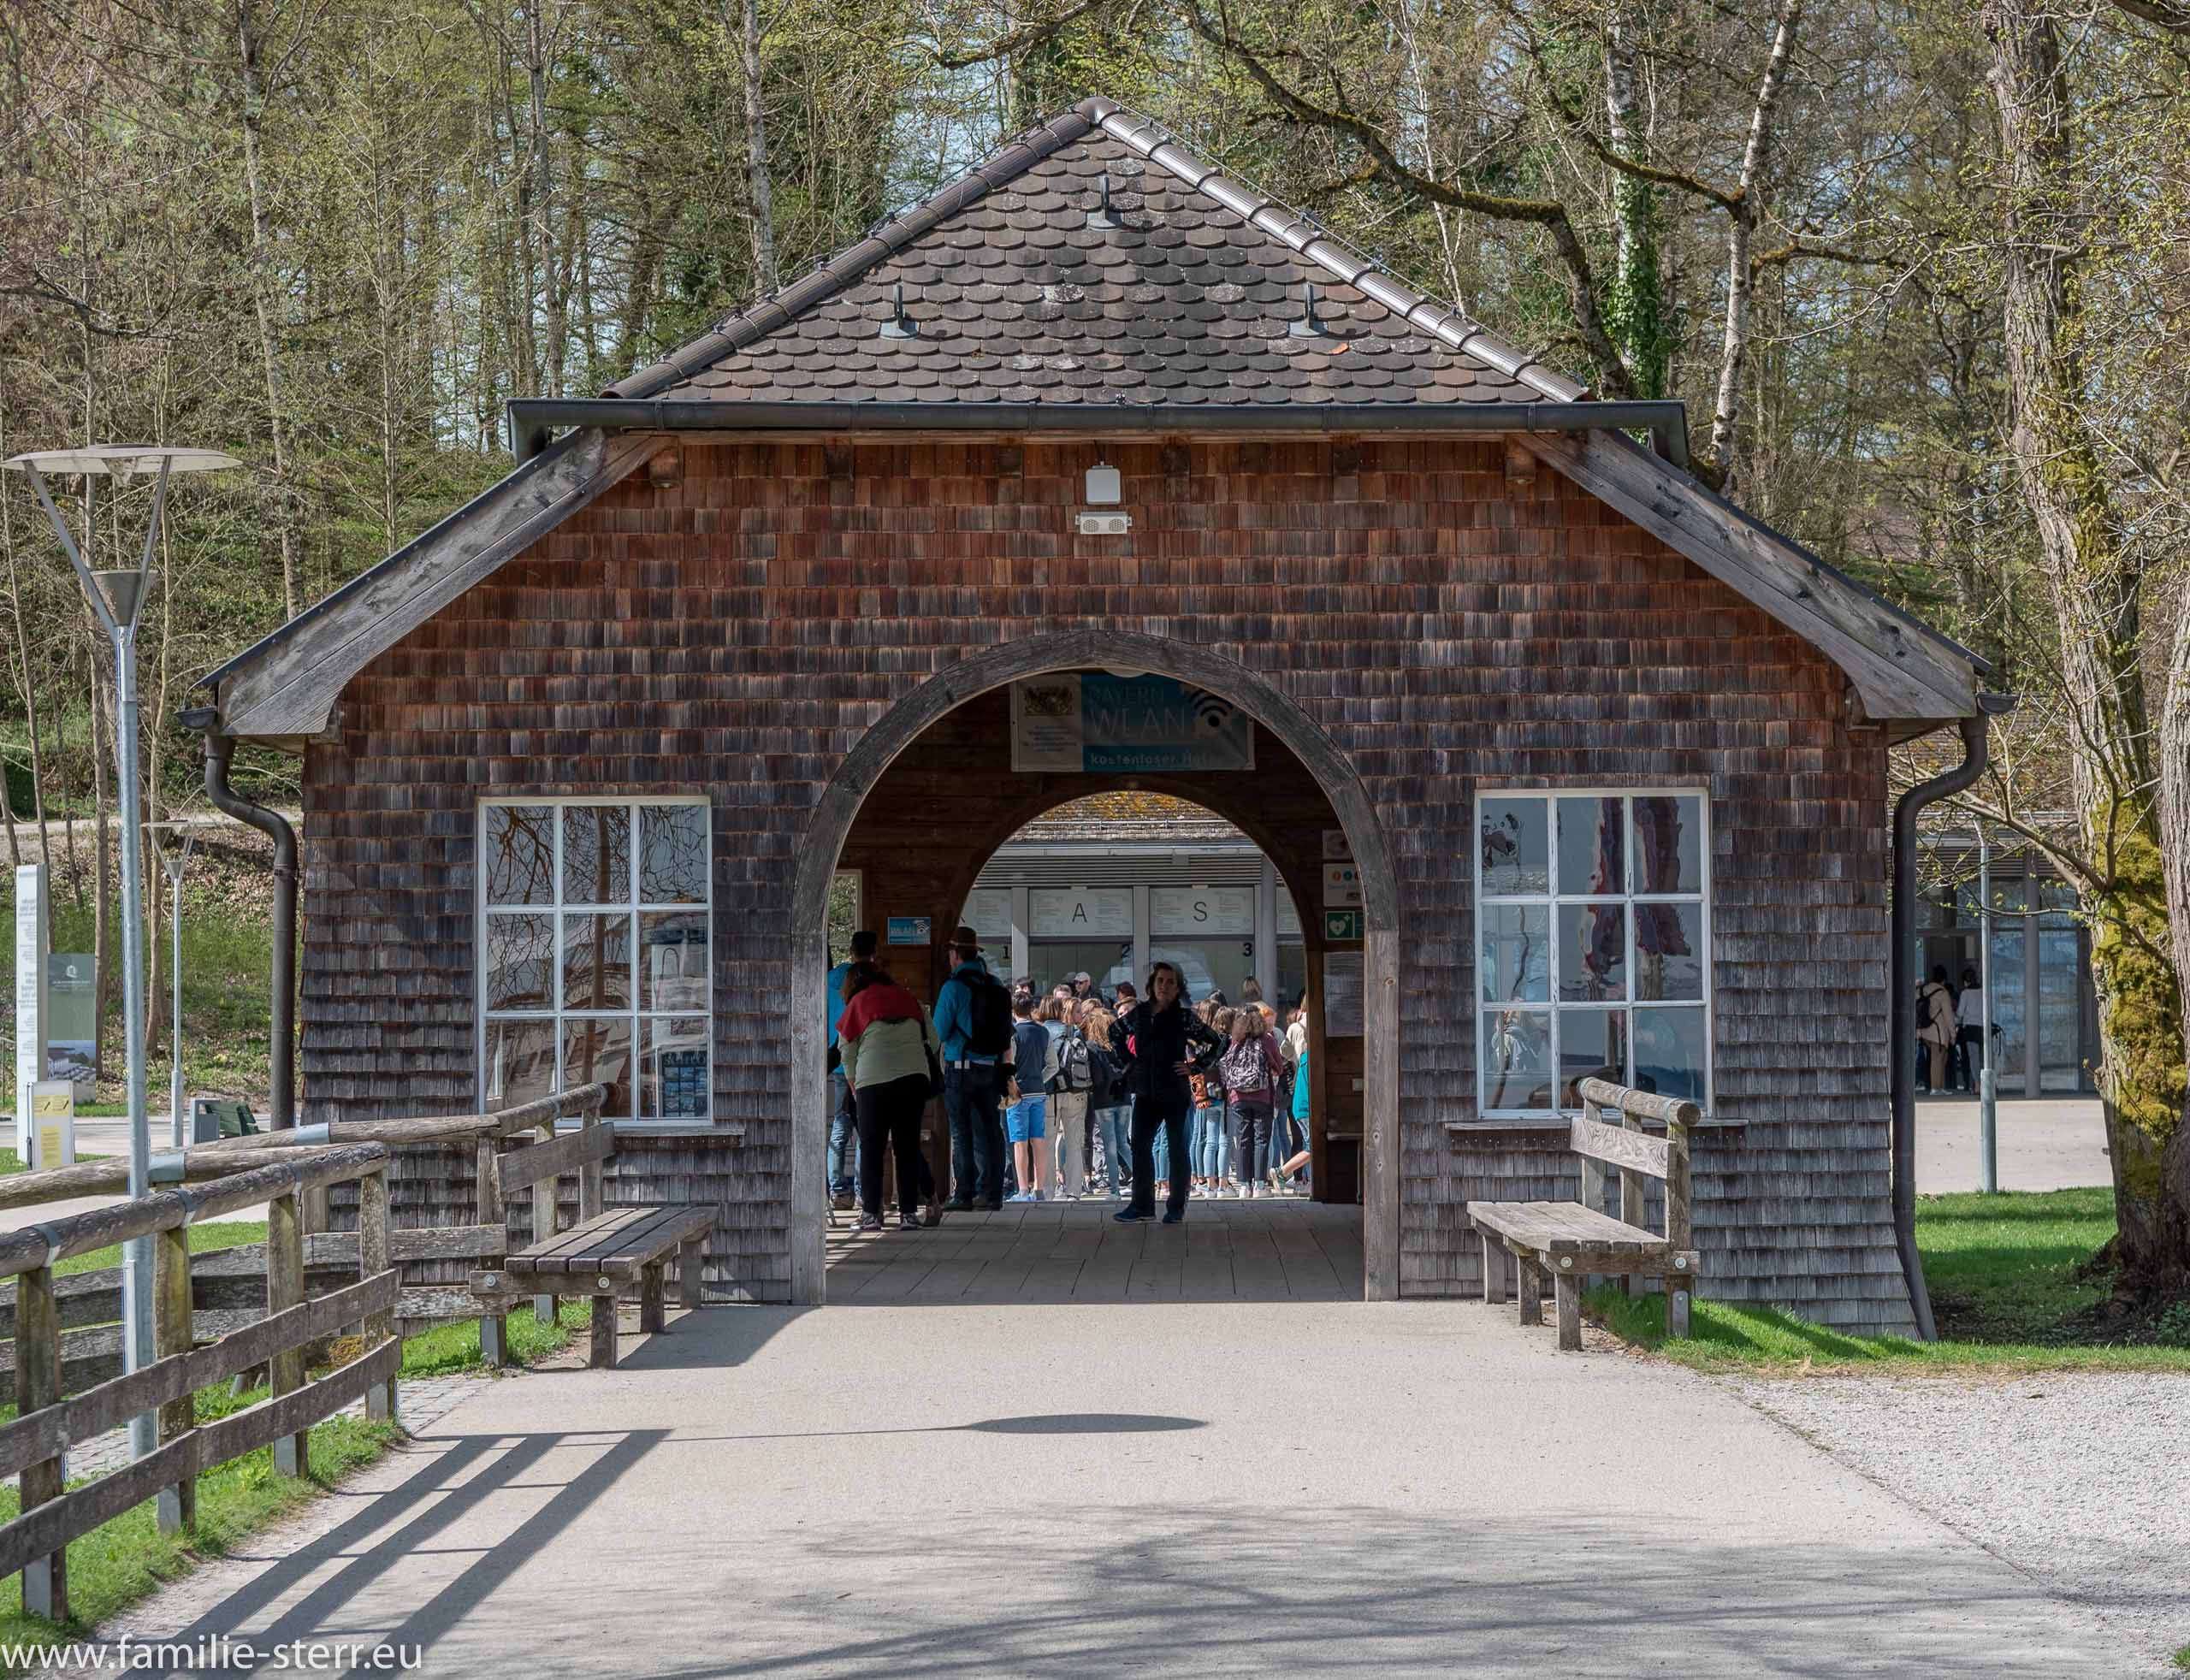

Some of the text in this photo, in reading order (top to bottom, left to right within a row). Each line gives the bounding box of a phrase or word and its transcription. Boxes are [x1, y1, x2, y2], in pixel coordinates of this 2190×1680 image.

[1089, 685, 1163, 704] BAYERN
[1089, 706, 1185, 738] WLAN
[1091, 751, 1177, 767] kostenloser
[1071, 902, 1088, 923] A
[1193, 902, 1207, 921] S
[1003, 946, 1010, 959] 1
[1122, 944, 1131, 958] 2
[1243, 943, 1253, 957] 3
